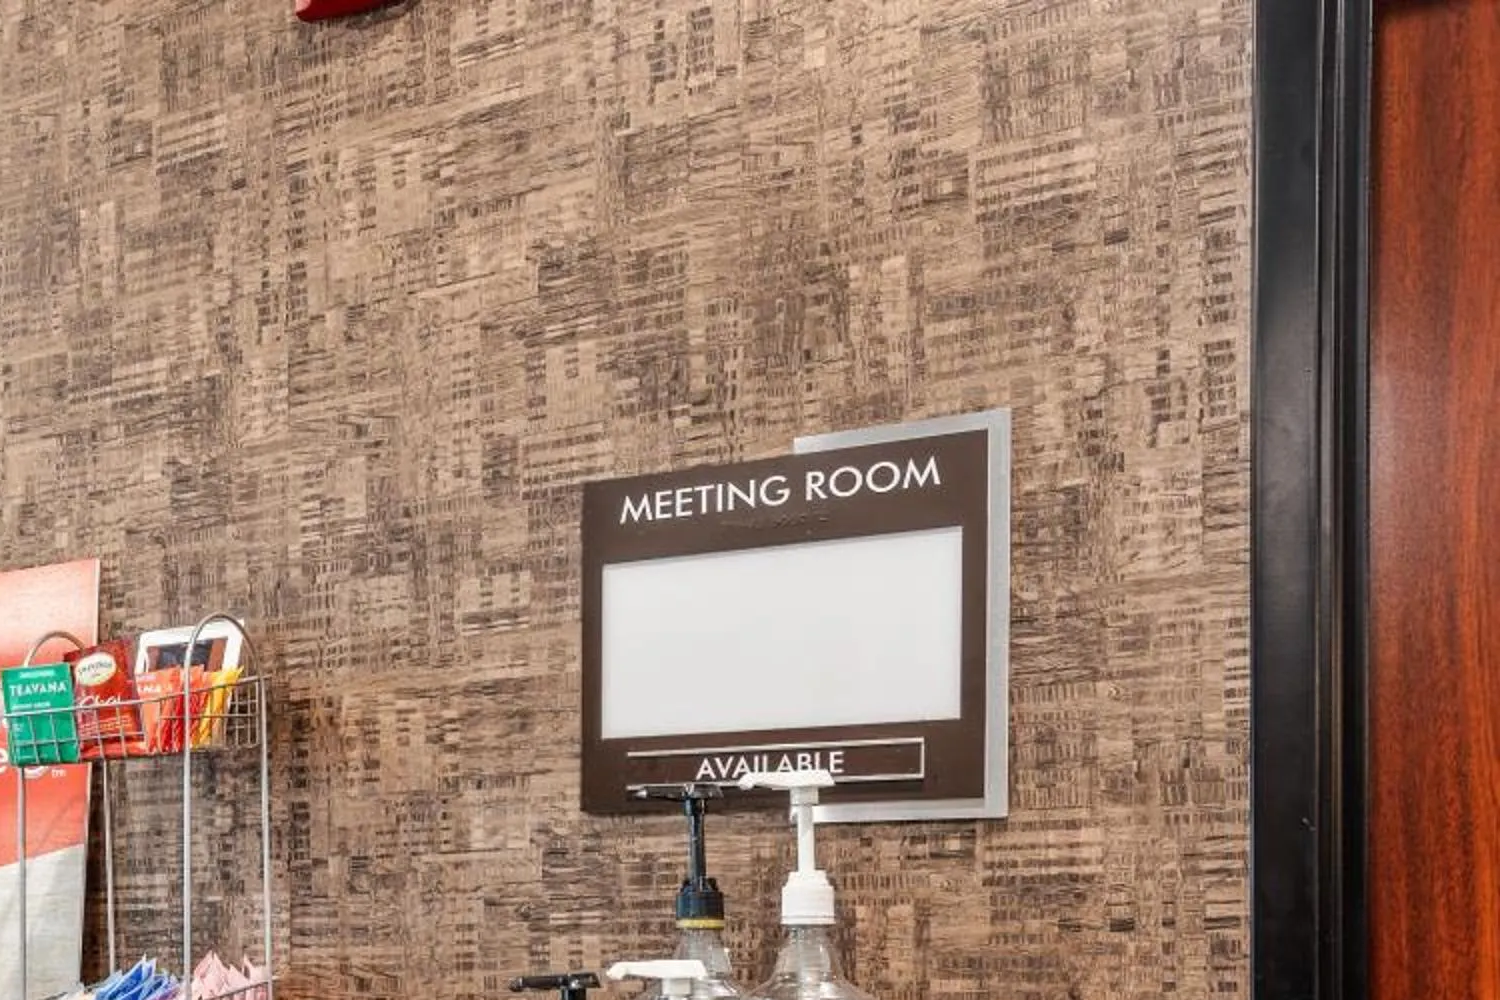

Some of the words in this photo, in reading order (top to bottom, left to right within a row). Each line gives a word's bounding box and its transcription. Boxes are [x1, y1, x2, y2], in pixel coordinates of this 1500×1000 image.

[619, 475, 791, 525] MEETING
[805, 456, 942, 502] ROOM
[8, 681, 67, 697] TEAVANA
[695, 751, 844, 780] AVAILABLE
